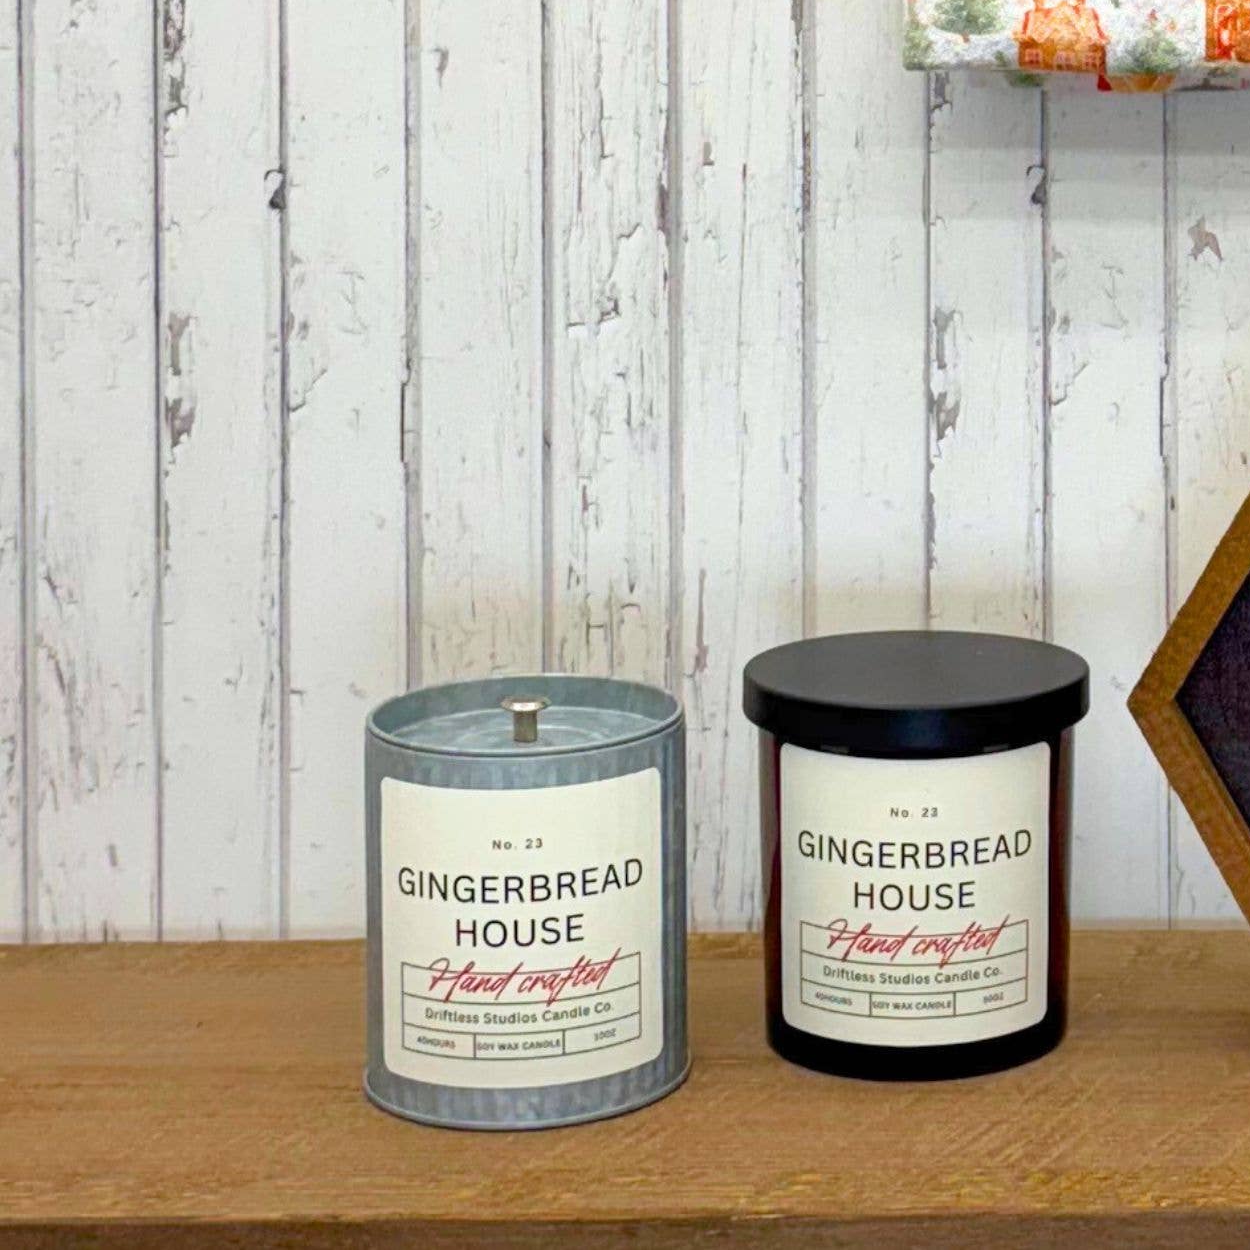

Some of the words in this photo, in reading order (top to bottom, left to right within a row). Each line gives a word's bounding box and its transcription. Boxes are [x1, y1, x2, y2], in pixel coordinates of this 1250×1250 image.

[921, 807, 938, 818] 23
[492, 839, 519, 850] No.
[525, 837, 543, 850] 23
[798, 829, 1032, 869] GINGERBREAD
[398, 858, 643, 904] GINGERBREAD
[854, 881, 975, 911] HOUSE
[455, 914, 585, 948] HOUSE
[827, 918, 919, 962] Hand
[912, 914, 1010, 970] crafted
[428, 957, 524, 1003] Hand
[518, 947, 622, 1007] crafted
[823, 965, 875, 983] Driftless
[879, 972, 930, 985] Studios
[934, 970, 980, 983] Candle
[425, 1006, 479, 1023] Driftless
[483, 1012, 538, 1025] Studios
[542, 1006, 591, 1022] Candle
[892, 1001, 913, 1010] WAX
[915, 1000, 952, 1010] CANDLE
[476, 1041, 496, 1051] SOY
[497, 1041, 519, 1051] WAX
[522, 1038, 560, 1050] CANDLE
